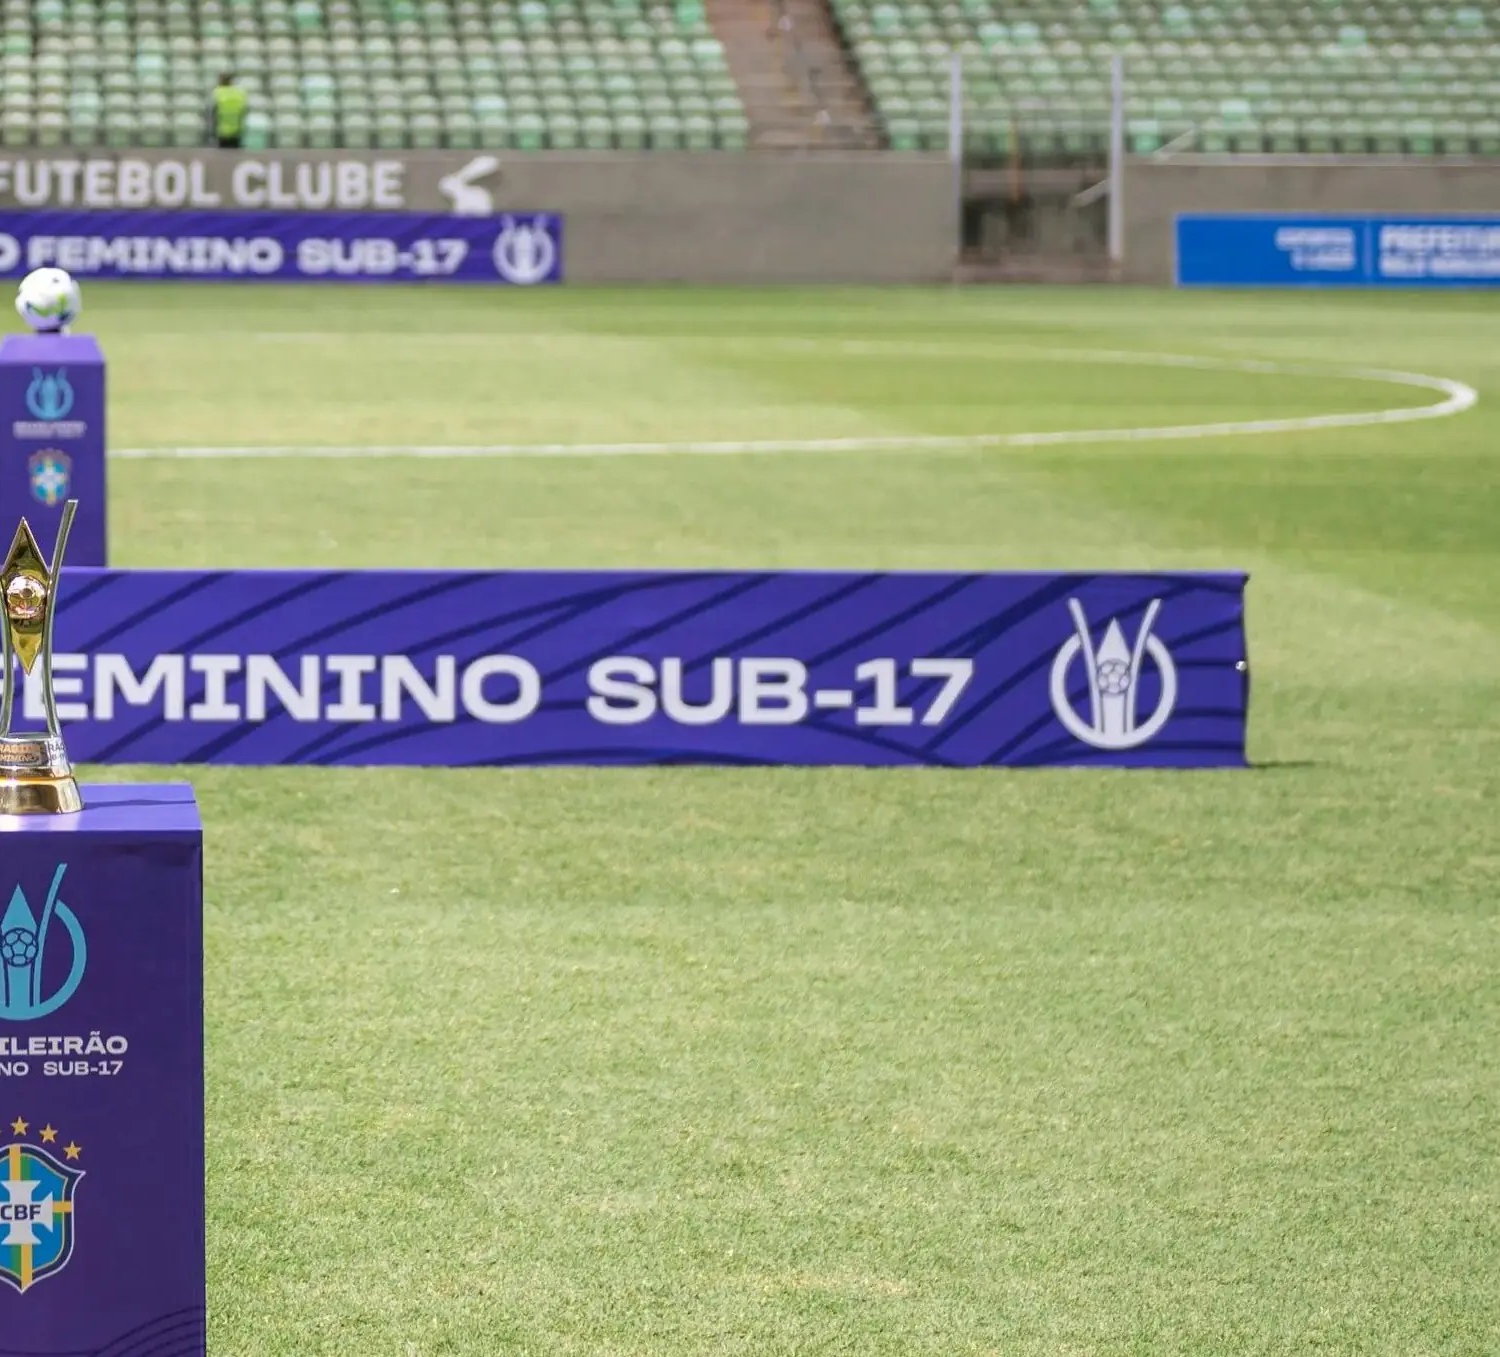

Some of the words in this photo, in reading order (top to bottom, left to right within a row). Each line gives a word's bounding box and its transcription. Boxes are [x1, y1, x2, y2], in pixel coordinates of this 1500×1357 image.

[232, 160, 404, 207] CLUBE
[27, 236, 284, 273] FEMININO
[297, 238, 468, 275] SUB-17
[587, 656, 974, 725] SUB-17
[43, 1060, 124, 1076] SUB-17
[0, 1204, 41, 1220] CBF
